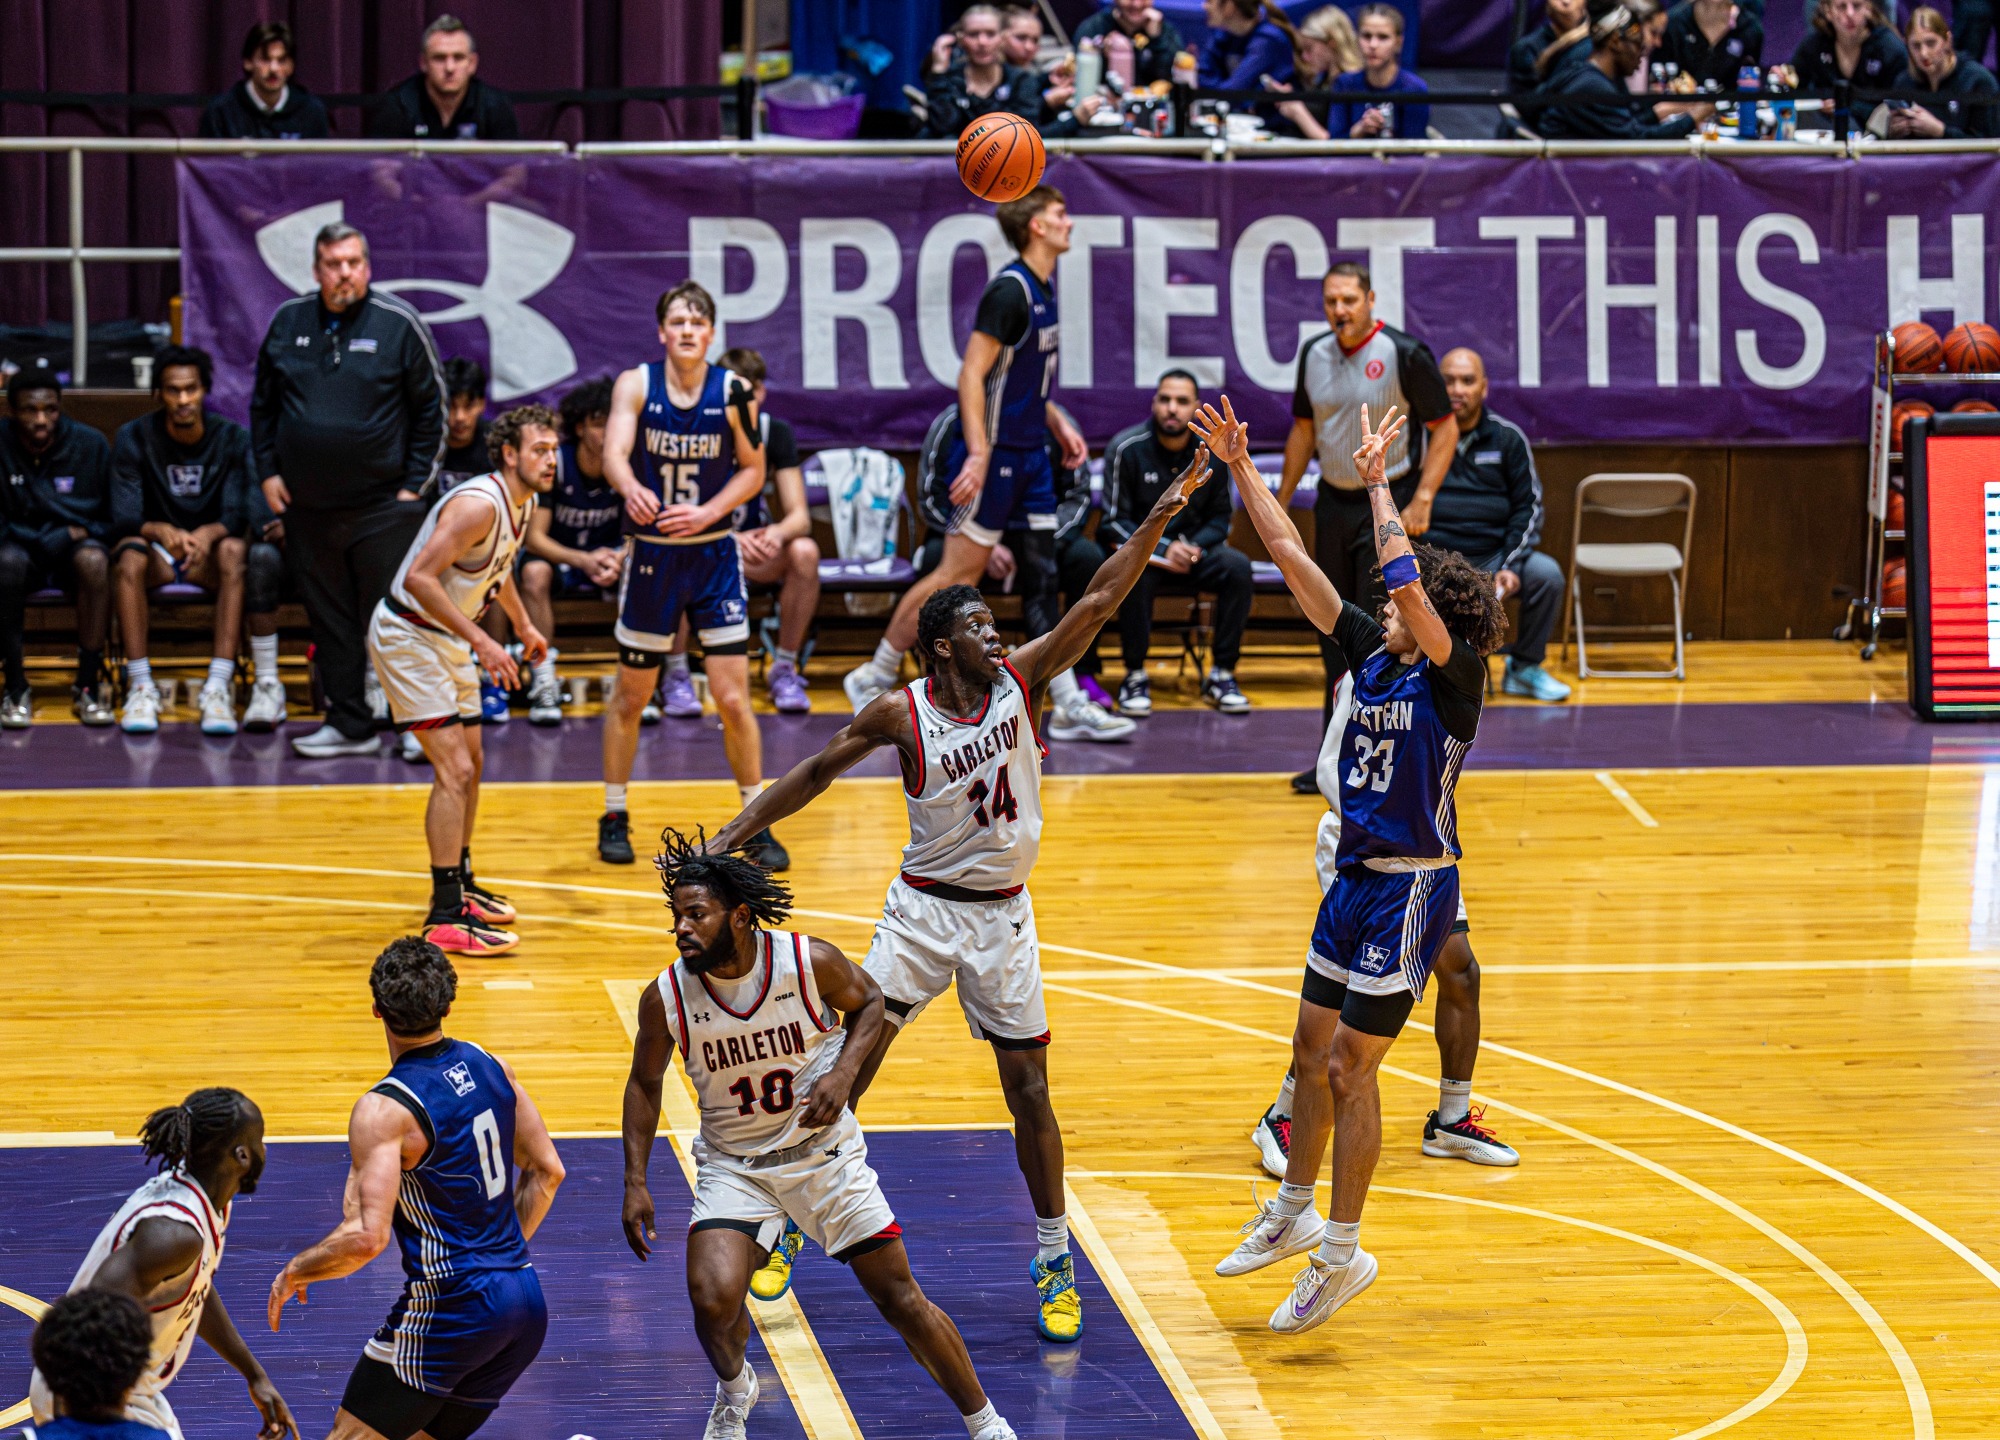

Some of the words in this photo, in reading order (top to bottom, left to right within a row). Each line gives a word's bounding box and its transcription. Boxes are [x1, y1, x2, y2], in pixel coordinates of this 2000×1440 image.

[688, 214, 1434, 392] PROTECT
[1478, 212, 1827, 390] THIS
[1886, 213, 2000, 329] H
[644, 427, 722, 459] WESTERN
[659, 462, 700, 506] 15
[940, 714, 1019, 784] CARLETON
[1346, 734, 1395, 793] 33
[966, 761, 1018, 828] 14
[774, 991, 796, 1002] OUA
[702, 1020, 806, 1073] CARLETON
[728, 1067, 795, 1117] 10
[472, 1107, 507, 1201] 0
